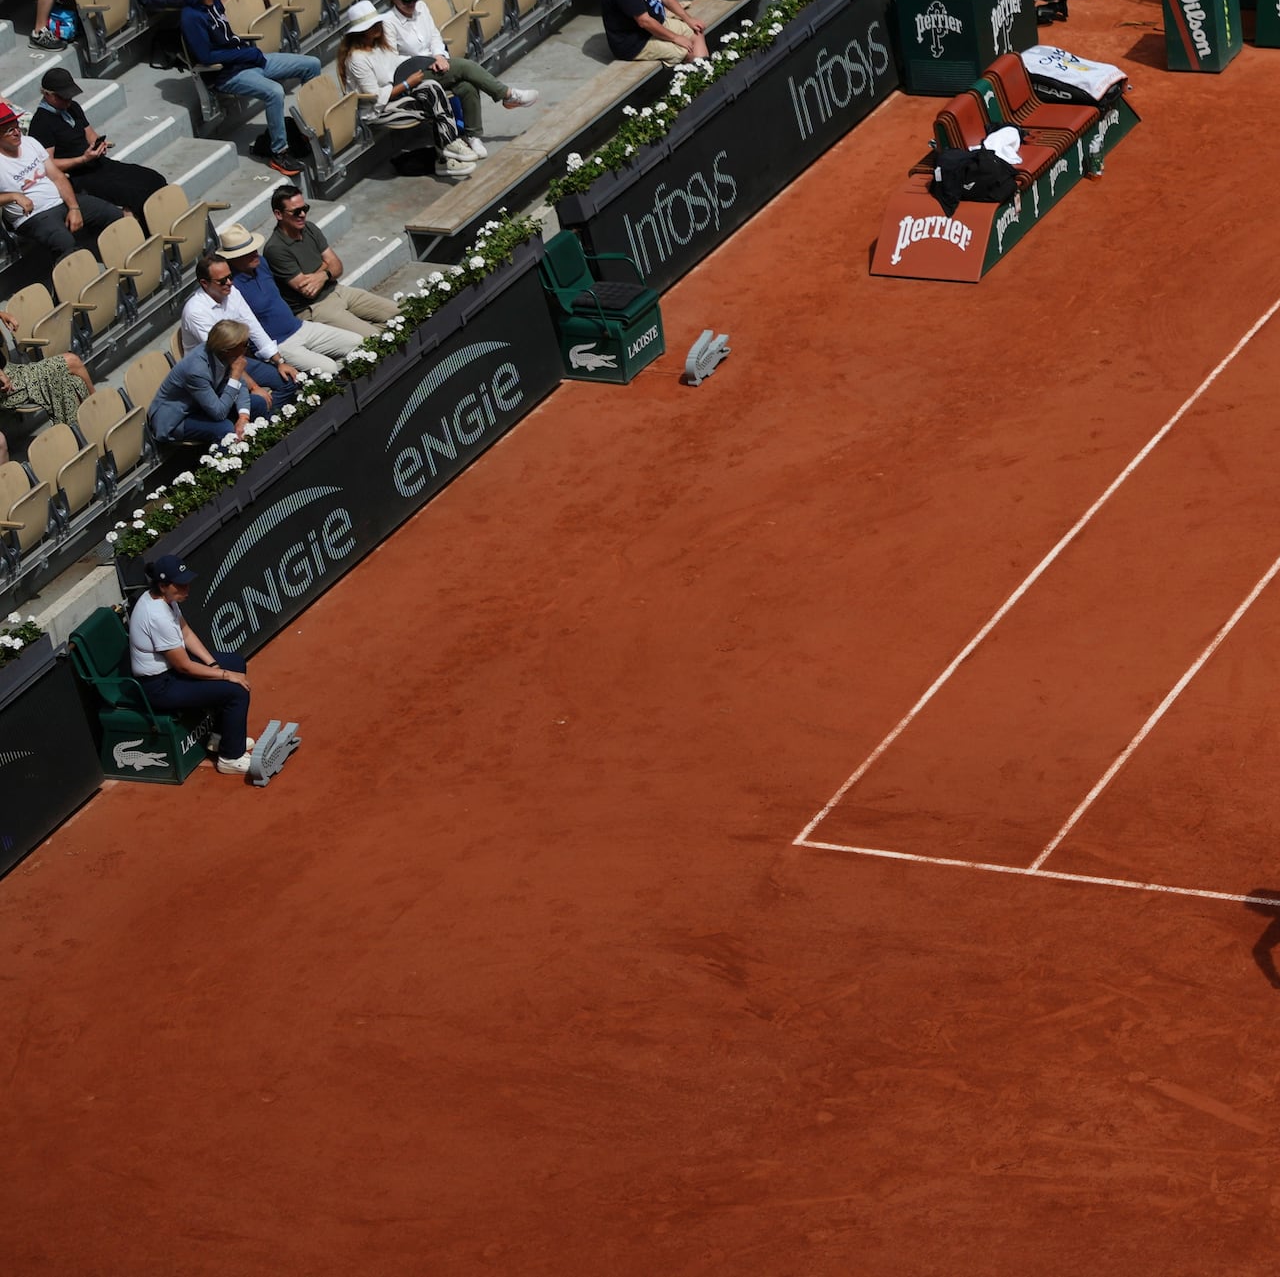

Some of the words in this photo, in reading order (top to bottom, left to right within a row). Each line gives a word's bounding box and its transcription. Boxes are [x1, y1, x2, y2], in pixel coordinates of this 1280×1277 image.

[788, 21, 890, 141] Infosys
[623, 150, 738, 280] Infosys
[627, 324, 659, 360] LACOSTE
